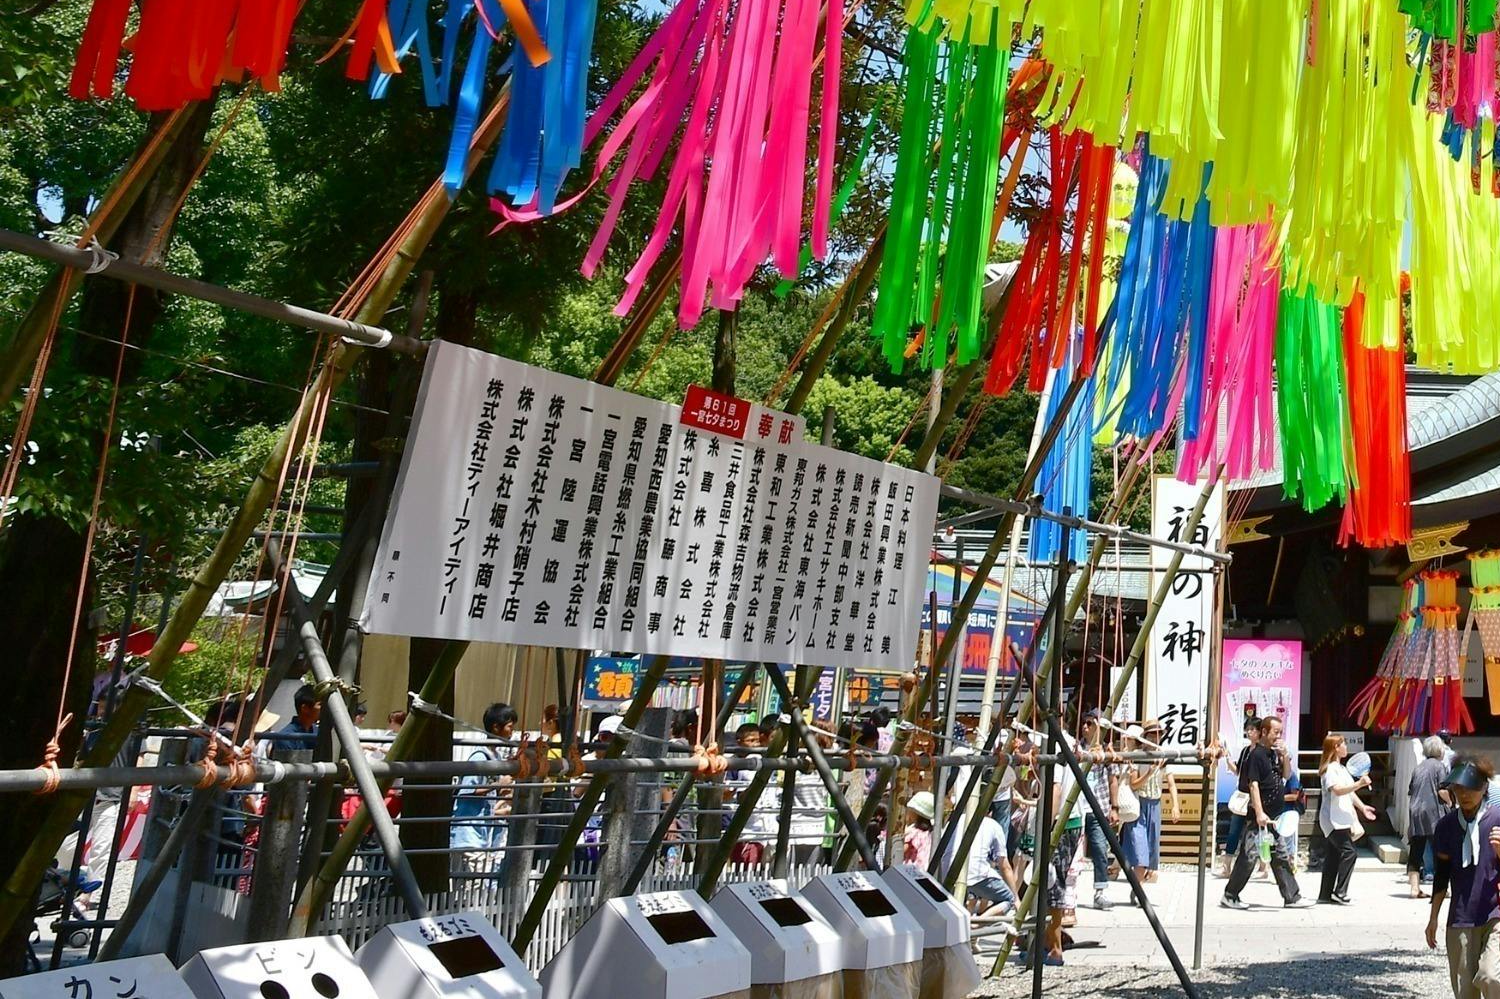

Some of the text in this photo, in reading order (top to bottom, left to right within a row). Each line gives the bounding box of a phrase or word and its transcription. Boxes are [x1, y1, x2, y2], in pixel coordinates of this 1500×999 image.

[440, 377, 504, 616] 株式会社ディーアイディー
[468, 386, 535, 620] 株式会社堀井商店
[501, 394, 565, 622] 株式会社木村硝子店
[533, 405, 594, 625] 一宮陸運協会
[564, 413, 621, 628] 一宮電話興業株式会社
[758, 413, 795, 445] 奉献
[621, 423, 673, 633] 愛知西農業協同組合
[673, 436, 720, 637] 糸喜株式会社
[697, 441, 744, 638] 三井食品工業株式会社
[720, 447, 766, 641] 株式会社森吉物流倉庫
[743, 452, 788, 643] 東和工業株式会社
[764, 458, 808, 645] 東邦ガス株式会社一宮営業所
[806, 468, 846, 649] 株式会社エサキホーム
[863, 481, 899, 653] 飯田興業株式会社
[1157, 505, 1210, 747] 福の神詣
[64, 974, 138, 999] カン
[256, 947, 316, 976] ビン
[419, 916, 477, 942] もえるゴミ
